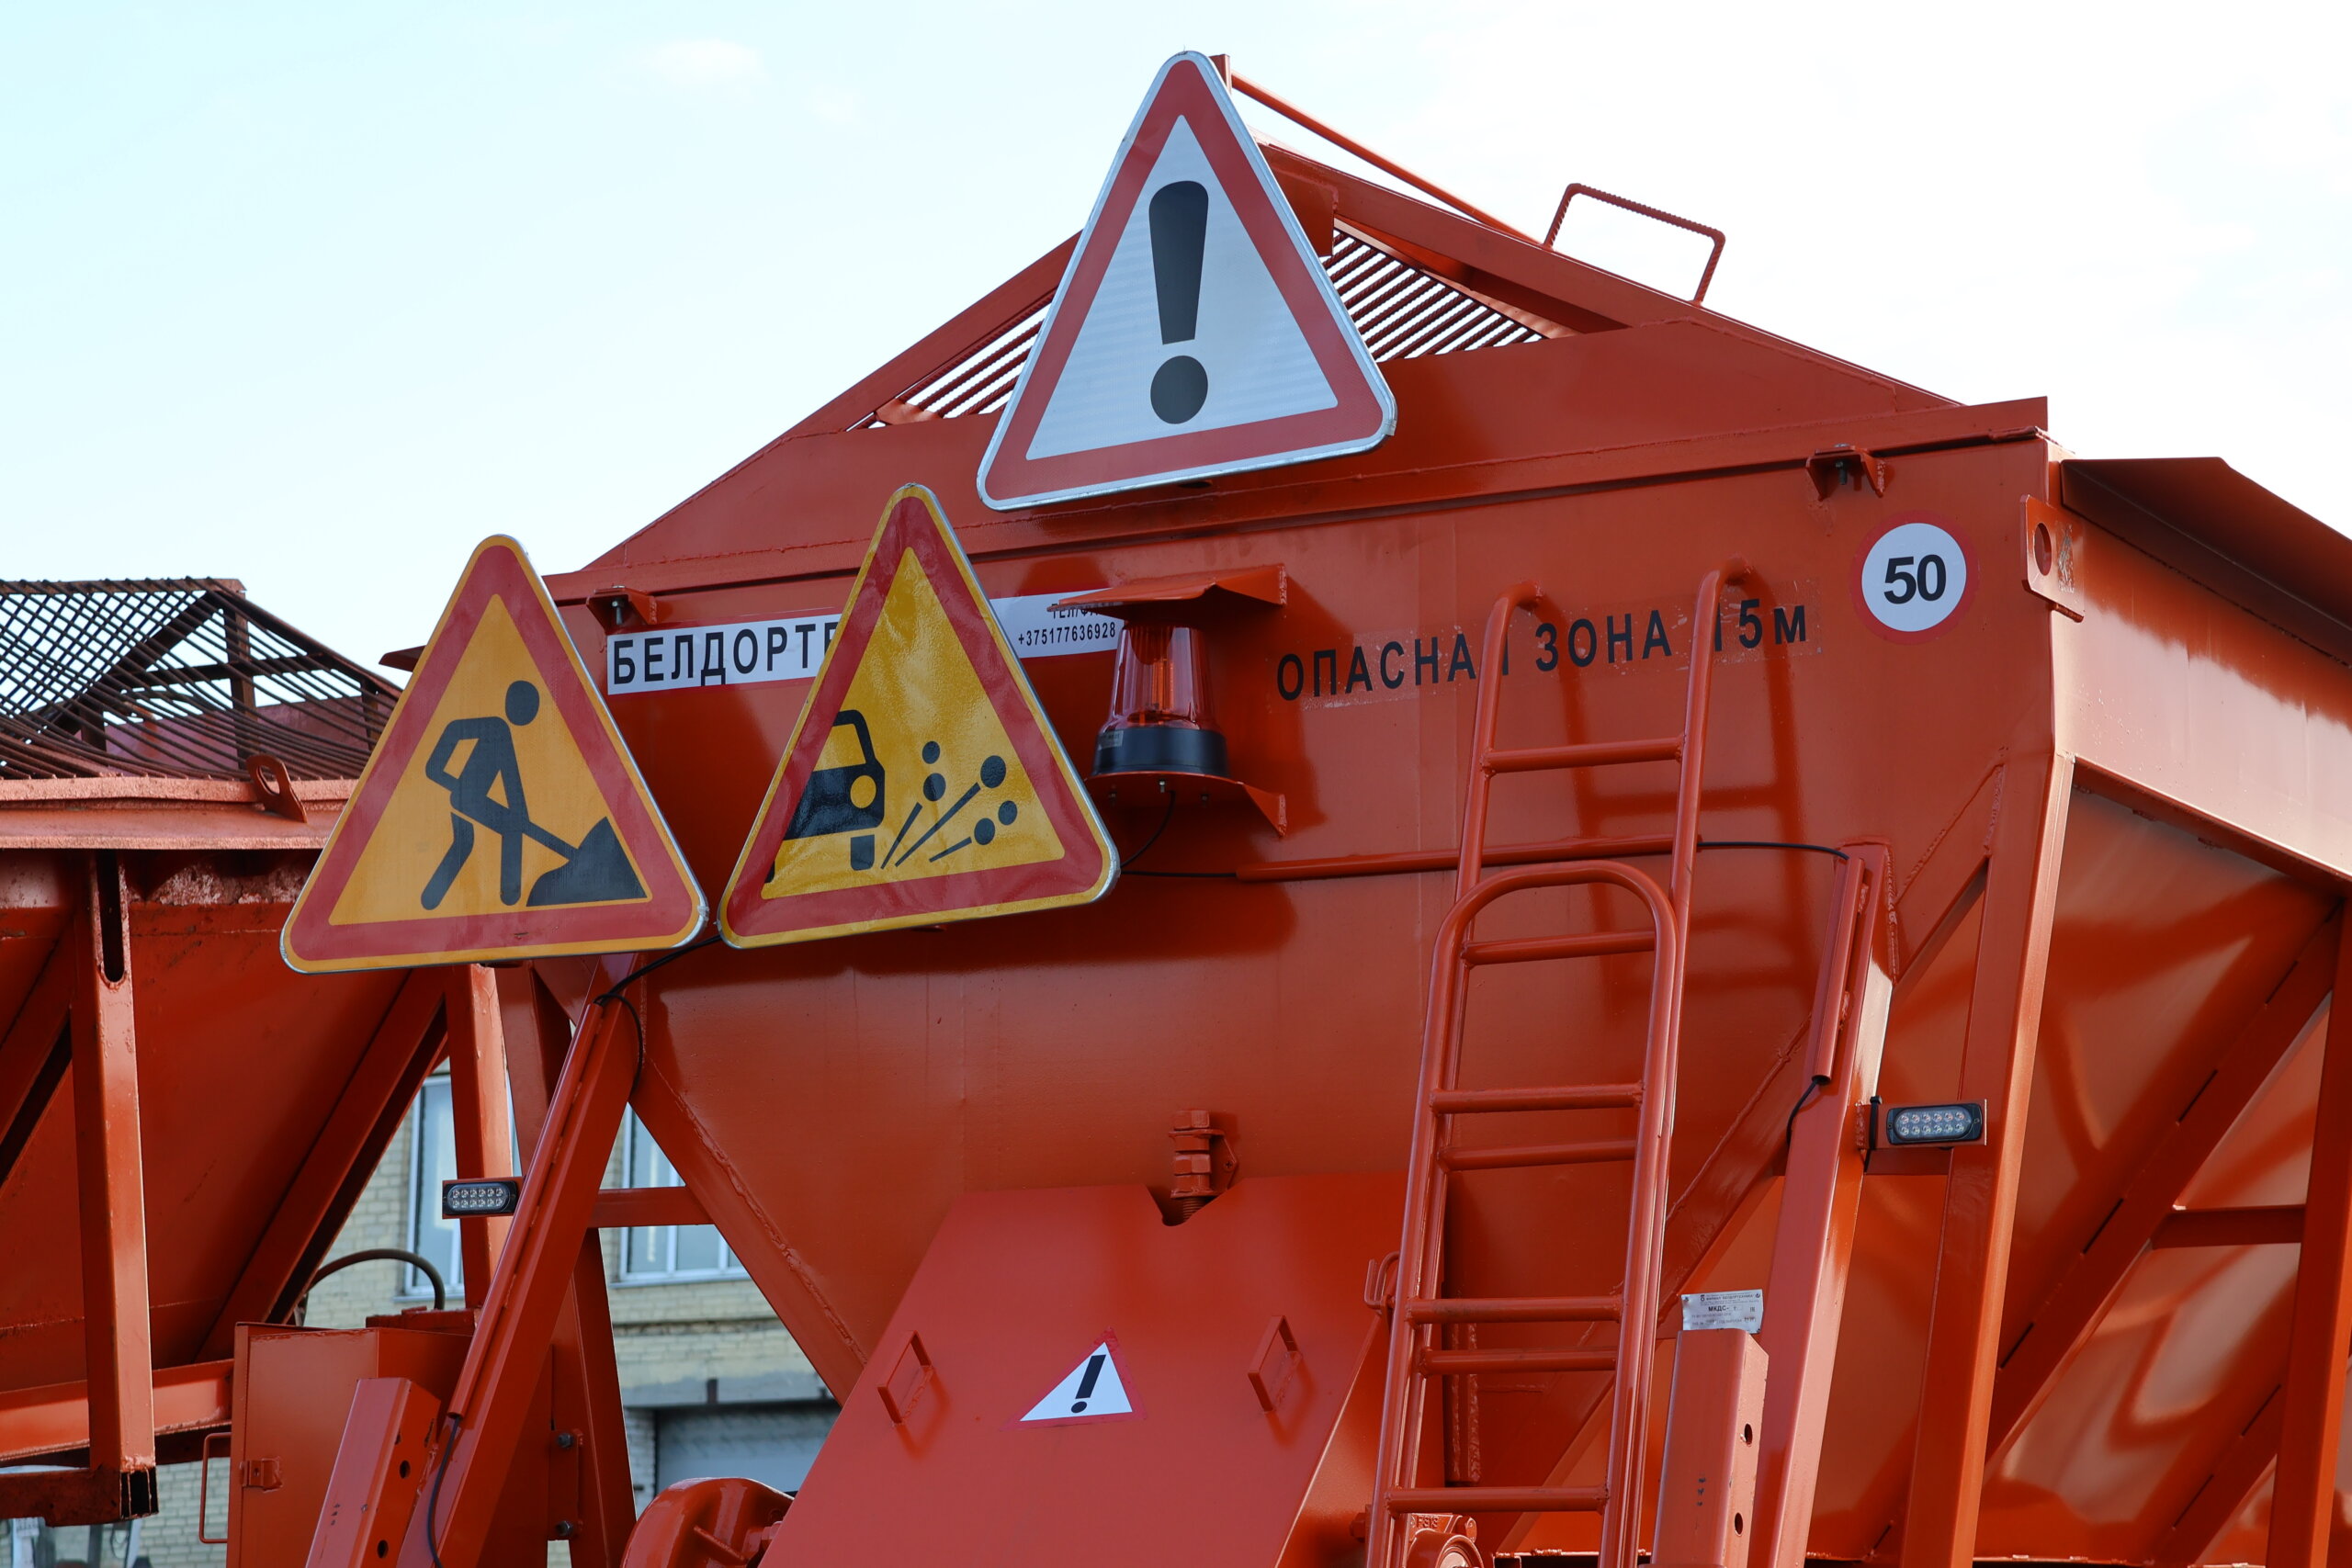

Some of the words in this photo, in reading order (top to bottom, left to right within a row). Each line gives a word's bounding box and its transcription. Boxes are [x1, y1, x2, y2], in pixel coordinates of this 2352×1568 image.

[1883, 554, 1948, 605] 50
[1018, 622, 1115, 646] +375177636928
[1535, 609, 1672, 672] ЗОНА
